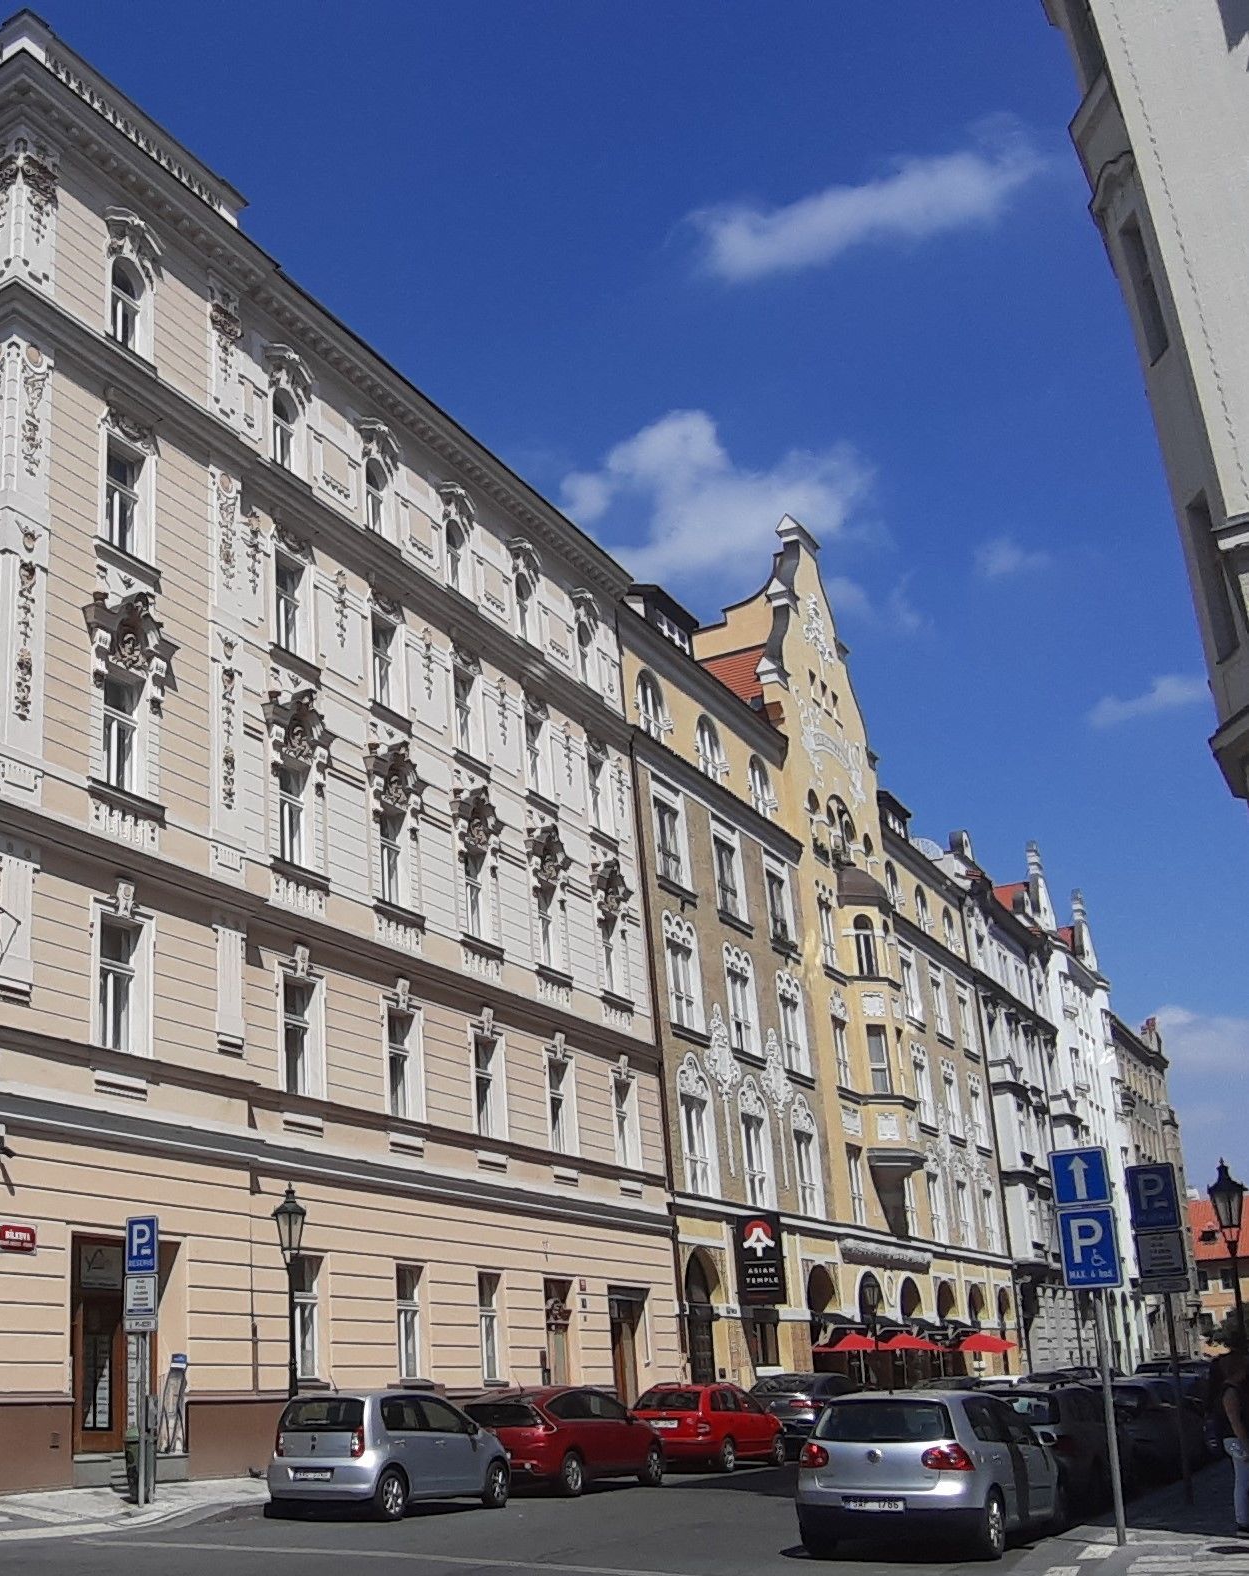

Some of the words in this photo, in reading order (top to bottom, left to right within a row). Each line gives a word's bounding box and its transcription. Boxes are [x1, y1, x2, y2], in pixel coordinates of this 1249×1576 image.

[132, 1224, 151, 1256] P
[1069, 1218, 1103, 1264] P
[746, 1276, 779, 1284] TEMPLE
[747, 1266, 776, 1274] ASIAN
